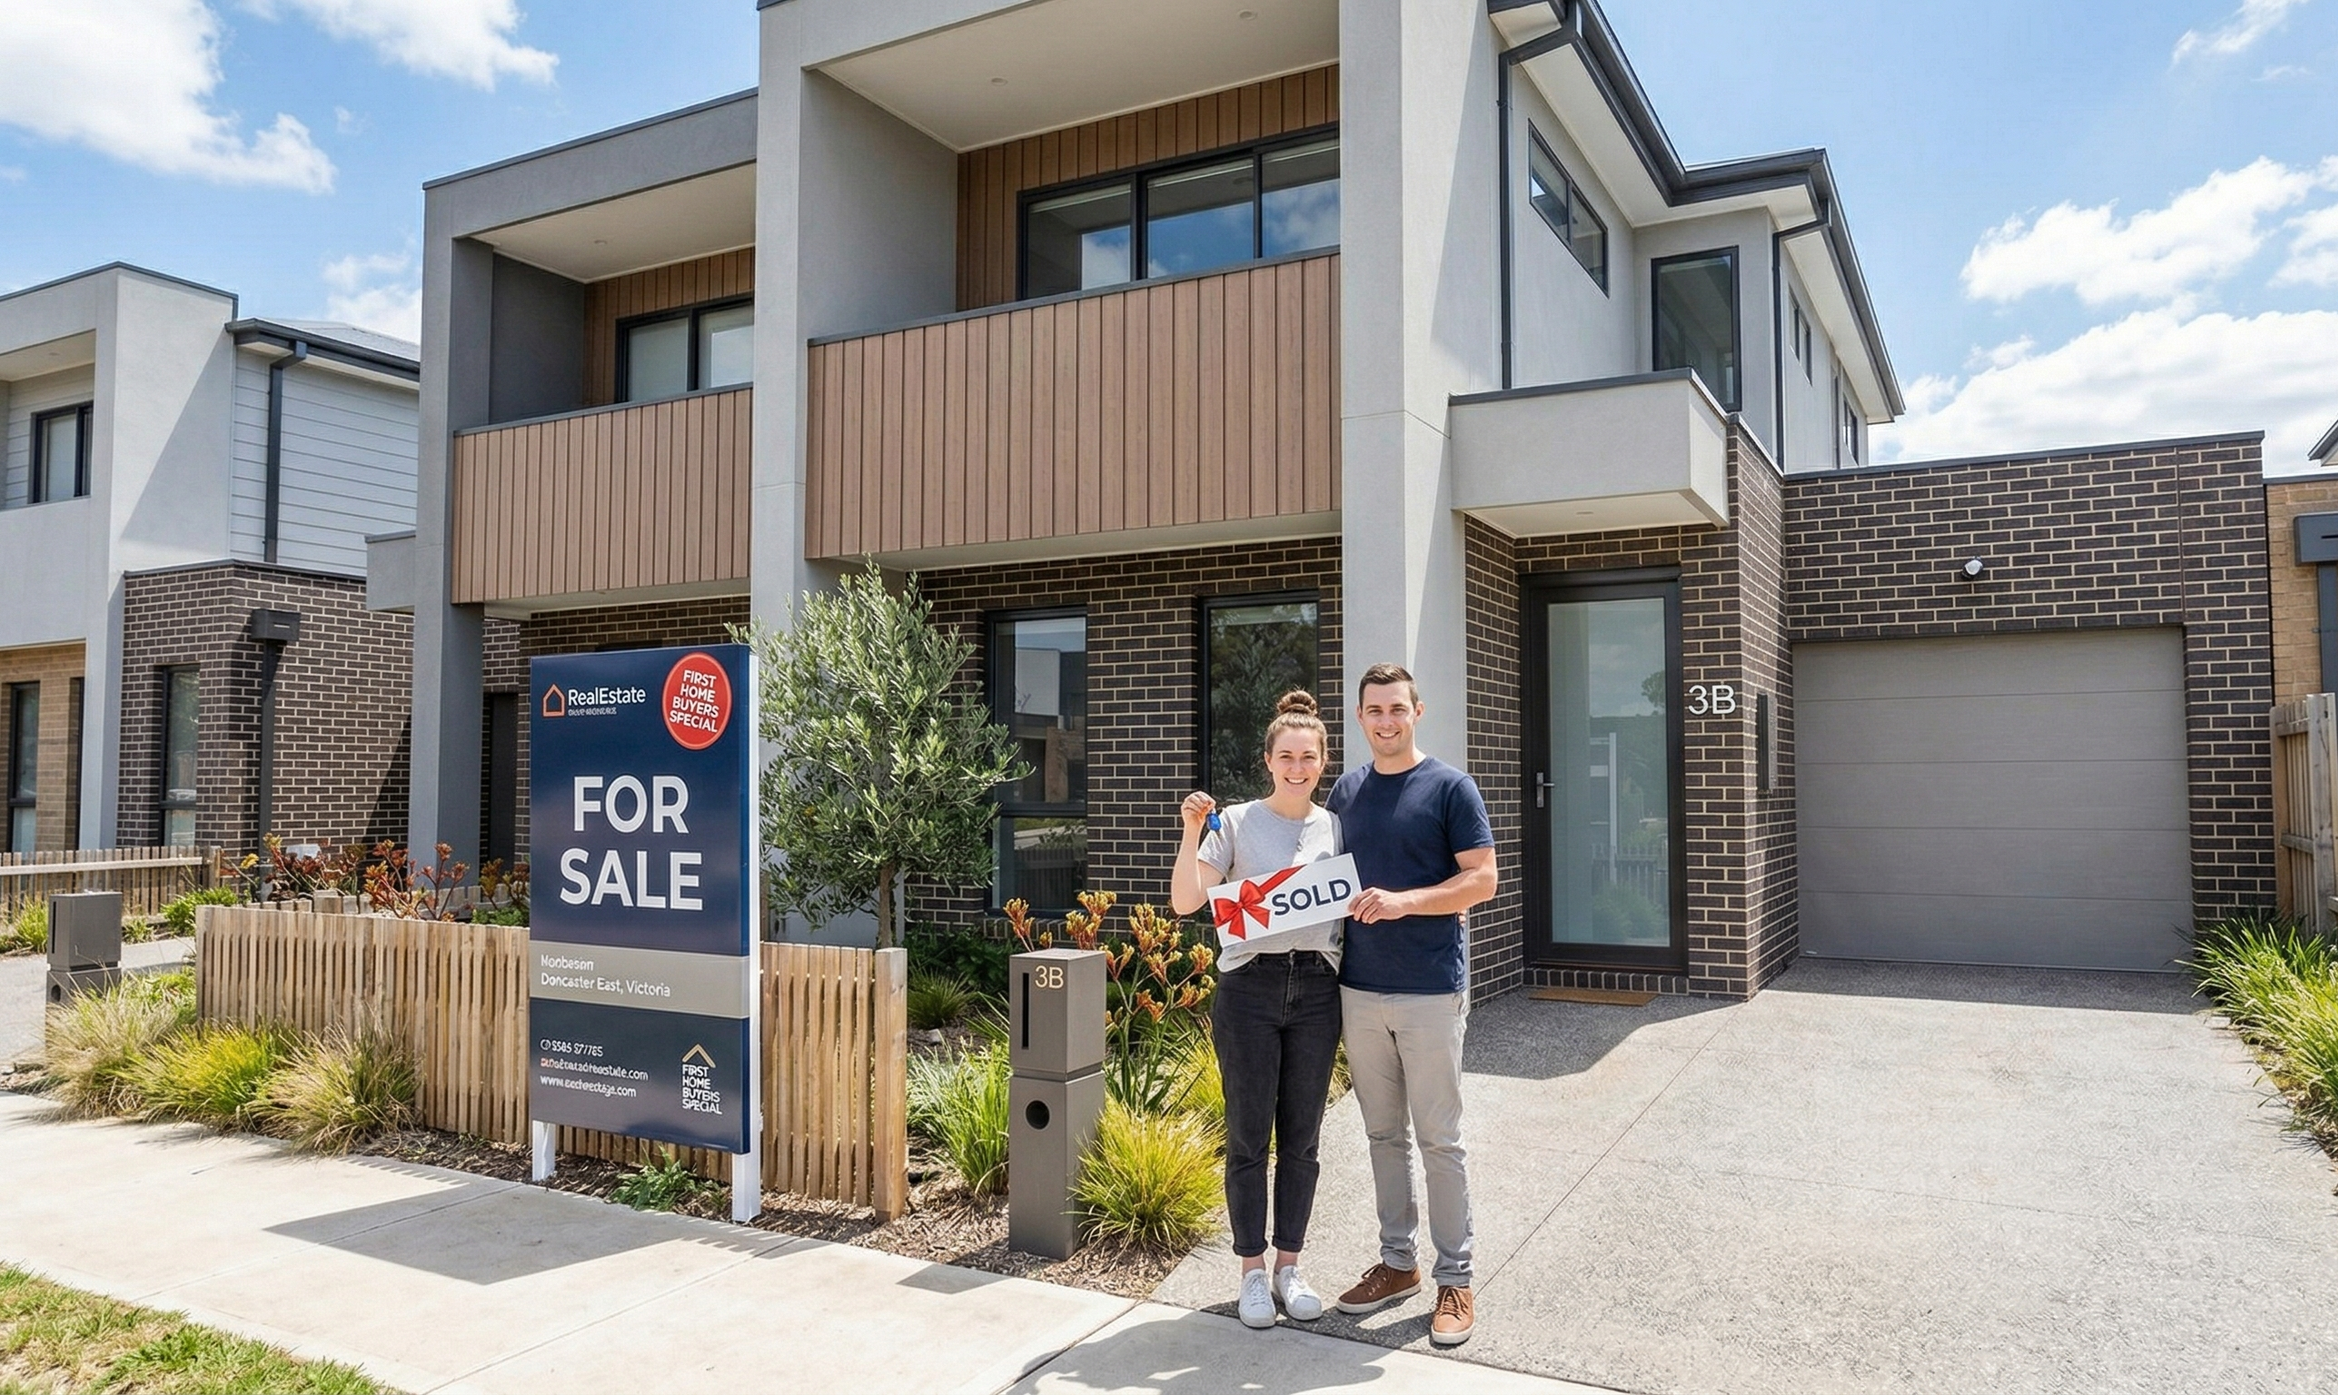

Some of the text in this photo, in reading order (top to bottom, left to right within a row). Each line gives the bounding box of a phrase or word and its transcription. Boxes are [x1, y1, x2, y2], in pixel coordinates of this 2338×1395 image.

[683, 669, 717, 688] FIRST
[568, 686, 646, 706] RealEstate
[680, 683, 716, 703] HOME
[1688, 685, 1736, 715] 3B
[672, 696, 719, 718] BUYERS
[574, 775, 690, 834] FOR
[560, 848, 703, 911] SALE
[1271, 879, 1352, 916] SOLD
[541, 972, 671, 997] Doncaster East, Victoria
[1035, 965, 1064, 989] 3B
[682, 1076, 711, 1089] HOME
